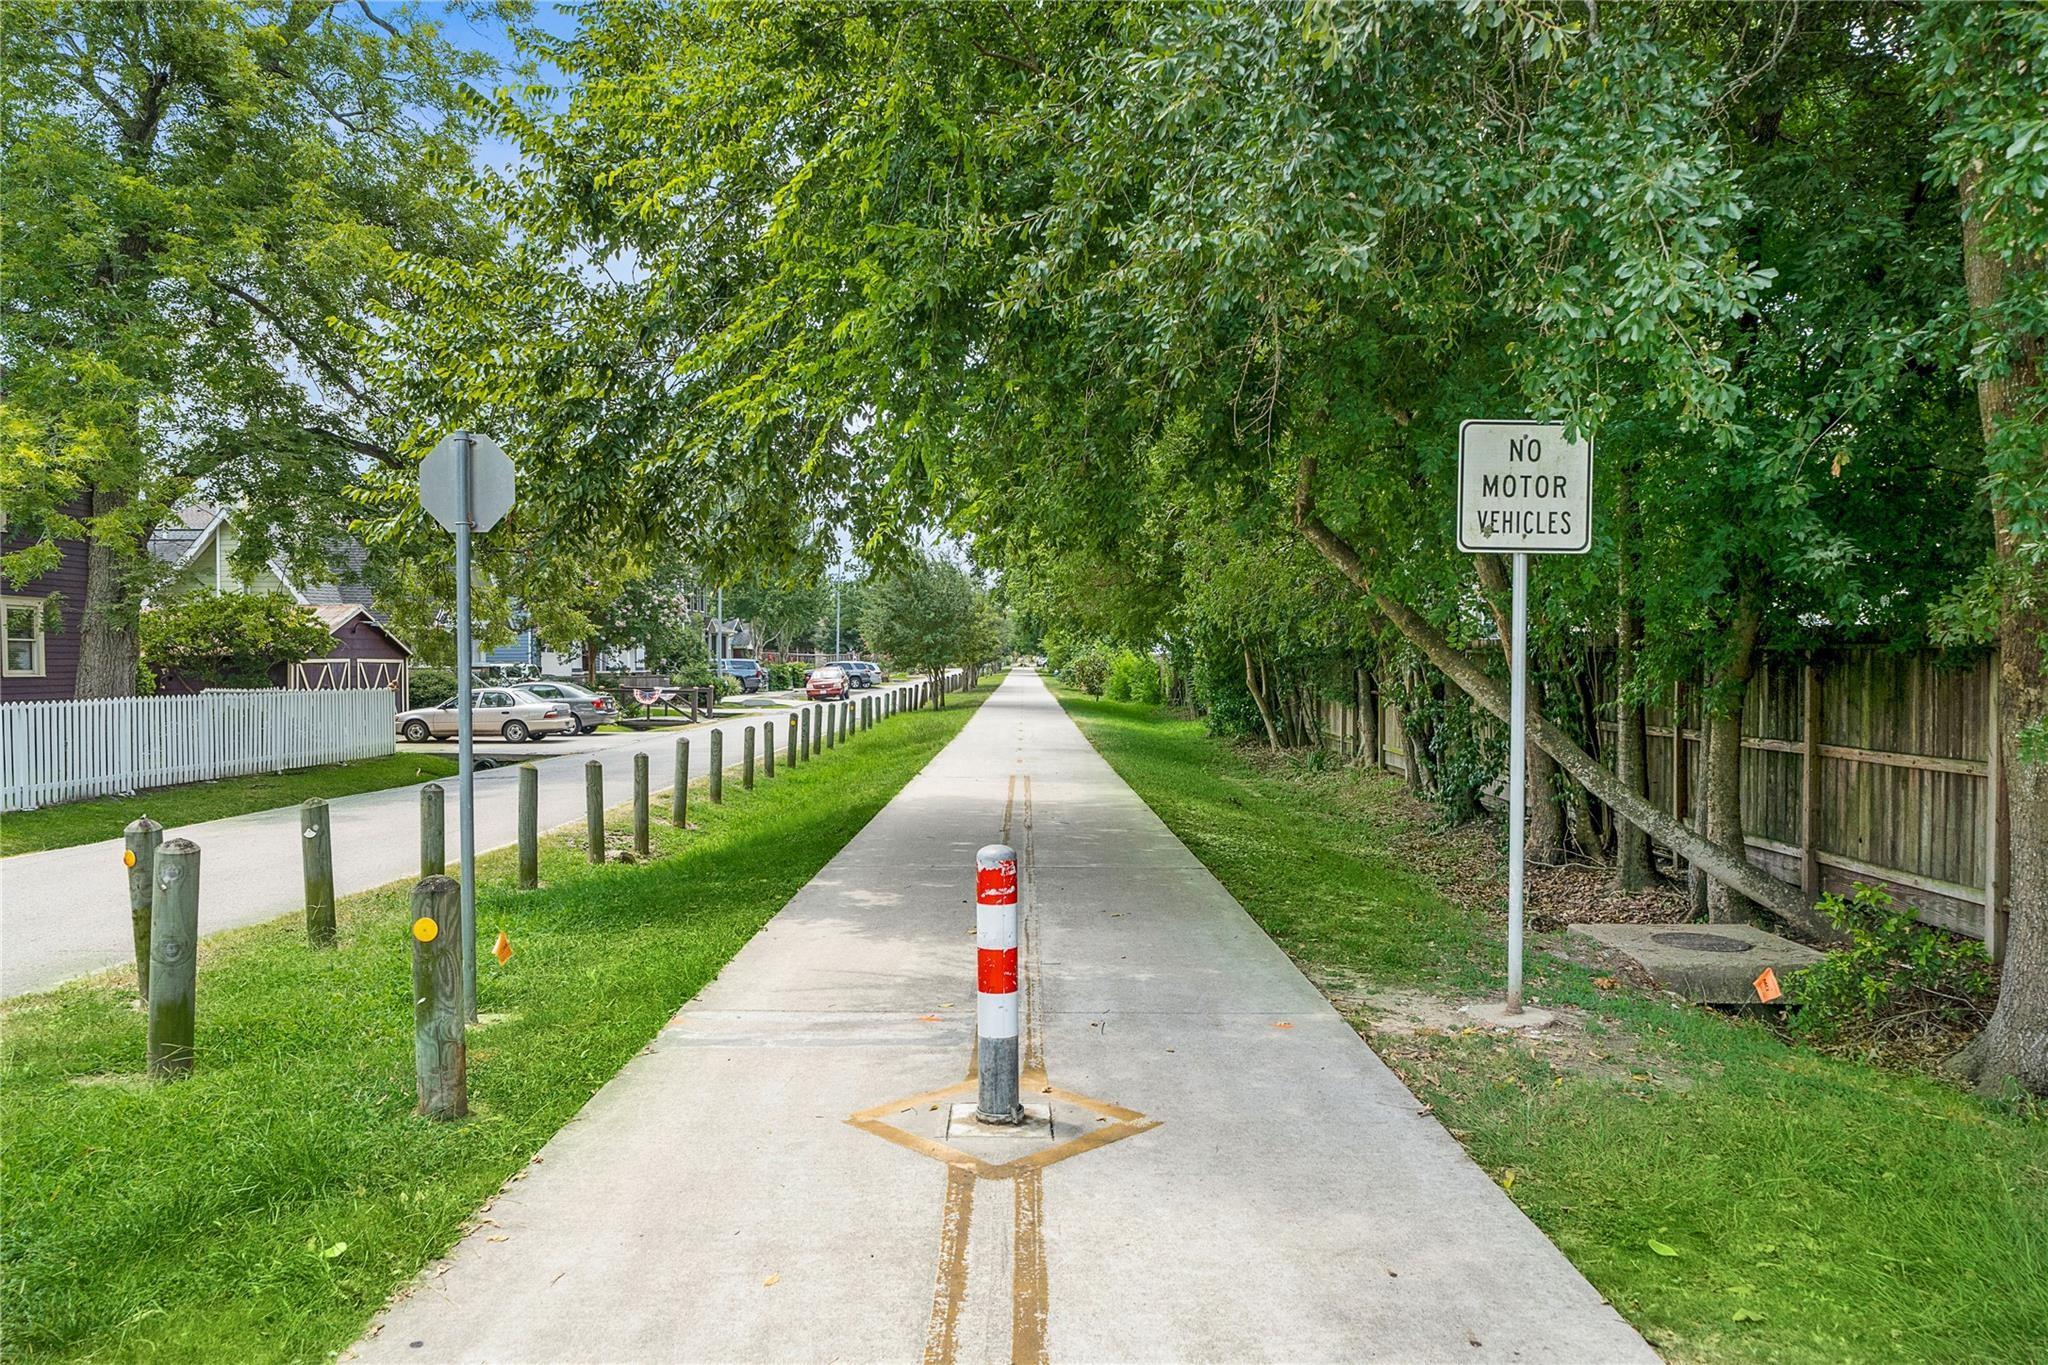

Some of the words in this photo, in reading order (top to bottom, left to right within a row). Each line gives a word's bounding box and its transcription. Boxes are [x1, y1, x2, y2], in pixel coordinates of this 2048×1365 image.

[1509, 438, 1541, 462] NO
[1482, 474, 1567, 498] MOTOR
[1477, 510, 1572, 535] VEHICLES
